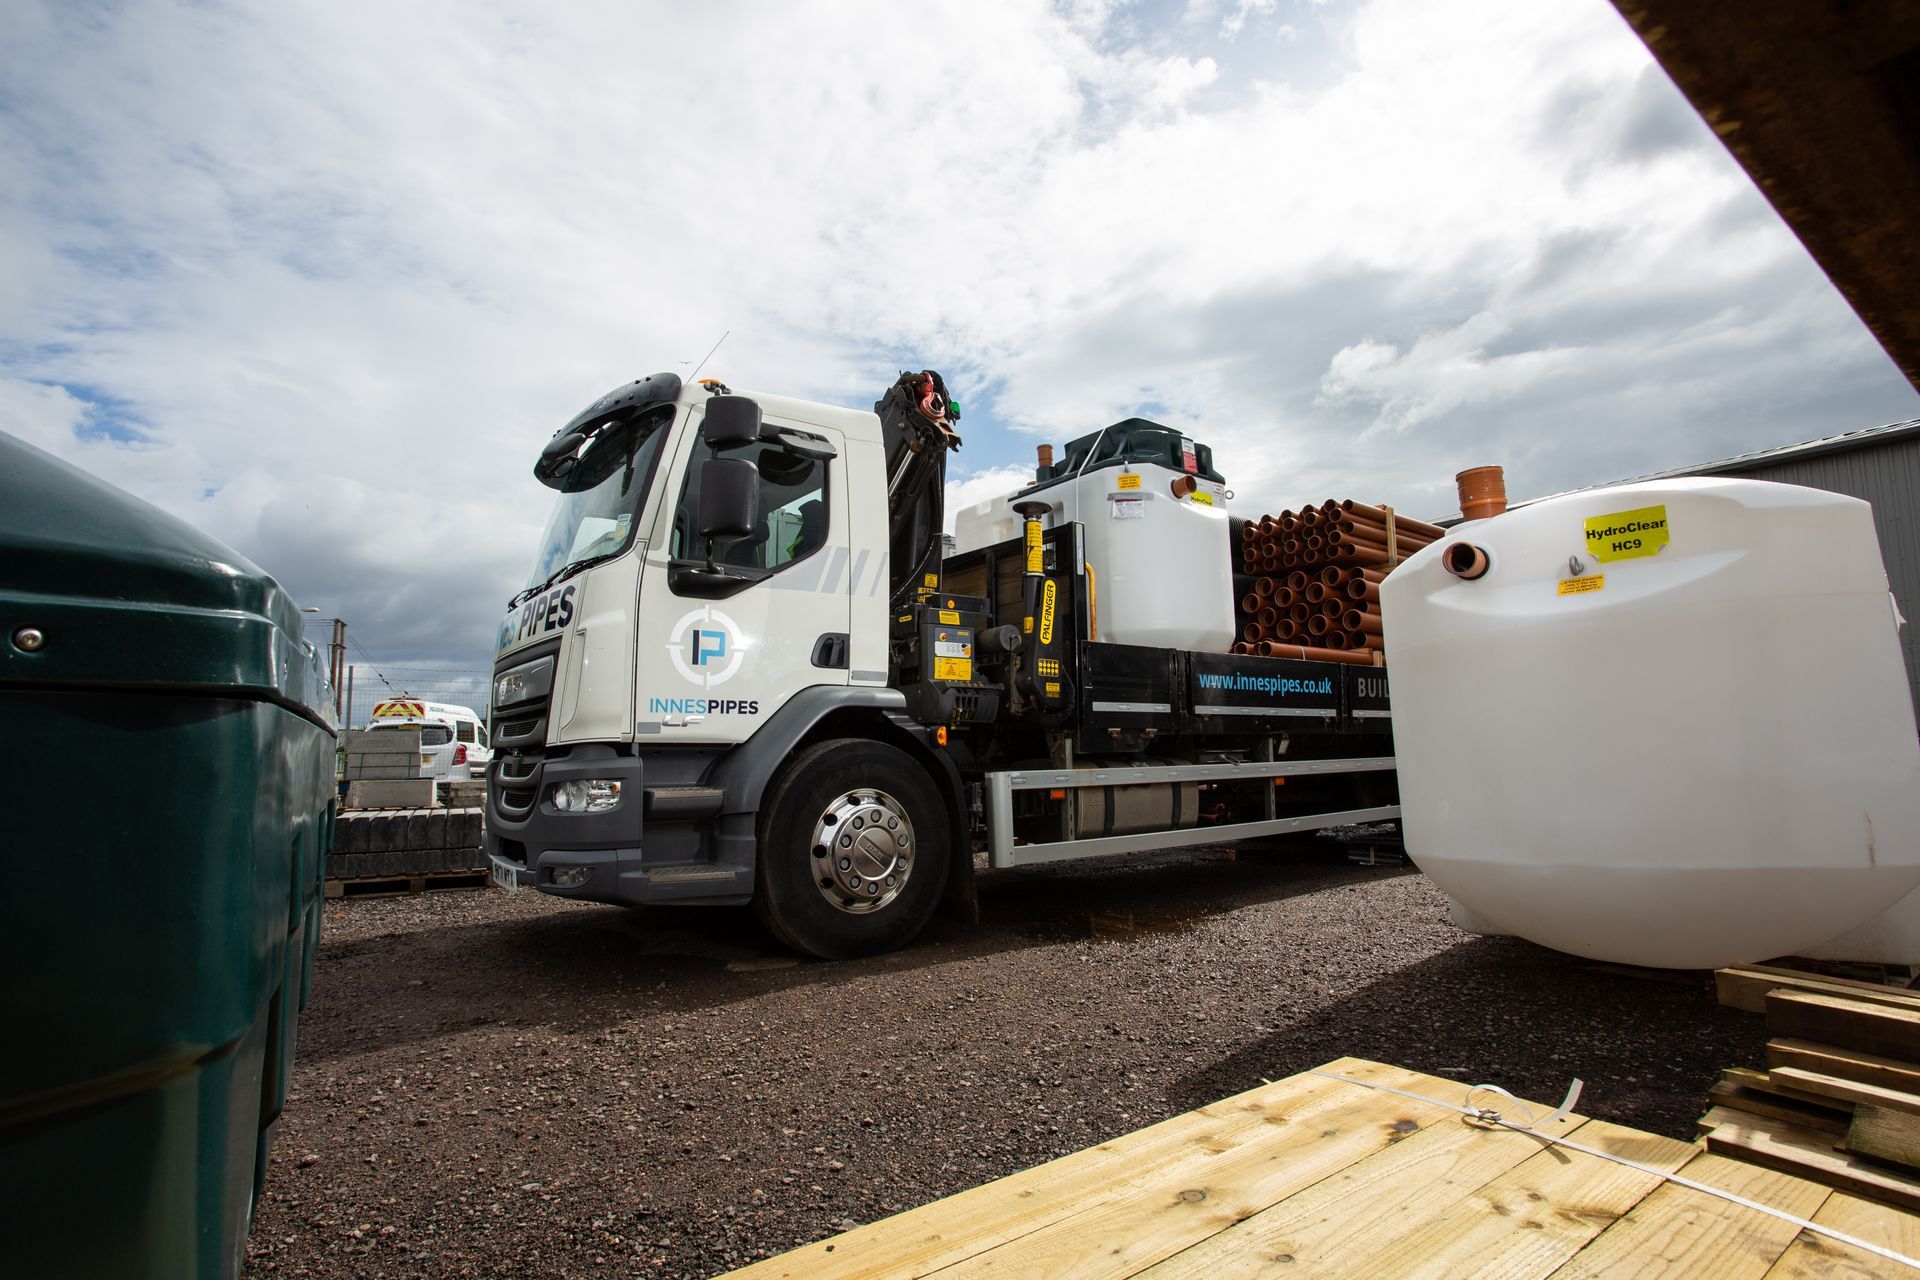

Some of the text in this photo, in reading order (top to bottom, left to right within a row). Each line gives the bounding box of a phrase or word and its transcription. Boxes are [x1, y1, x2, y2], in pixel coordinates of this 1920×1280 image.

[1586, 519, 1666, 541] HydroClear
[1612, 539, 1642, 552] HC9
[518, 585, 576, 641] PIPES
[1042, 584, 1054, 640] PALFINGER
[1199, 672, 1332, 696] www.innespipes.co.uk
[649, 698, 759, 714] INNESPIPES
